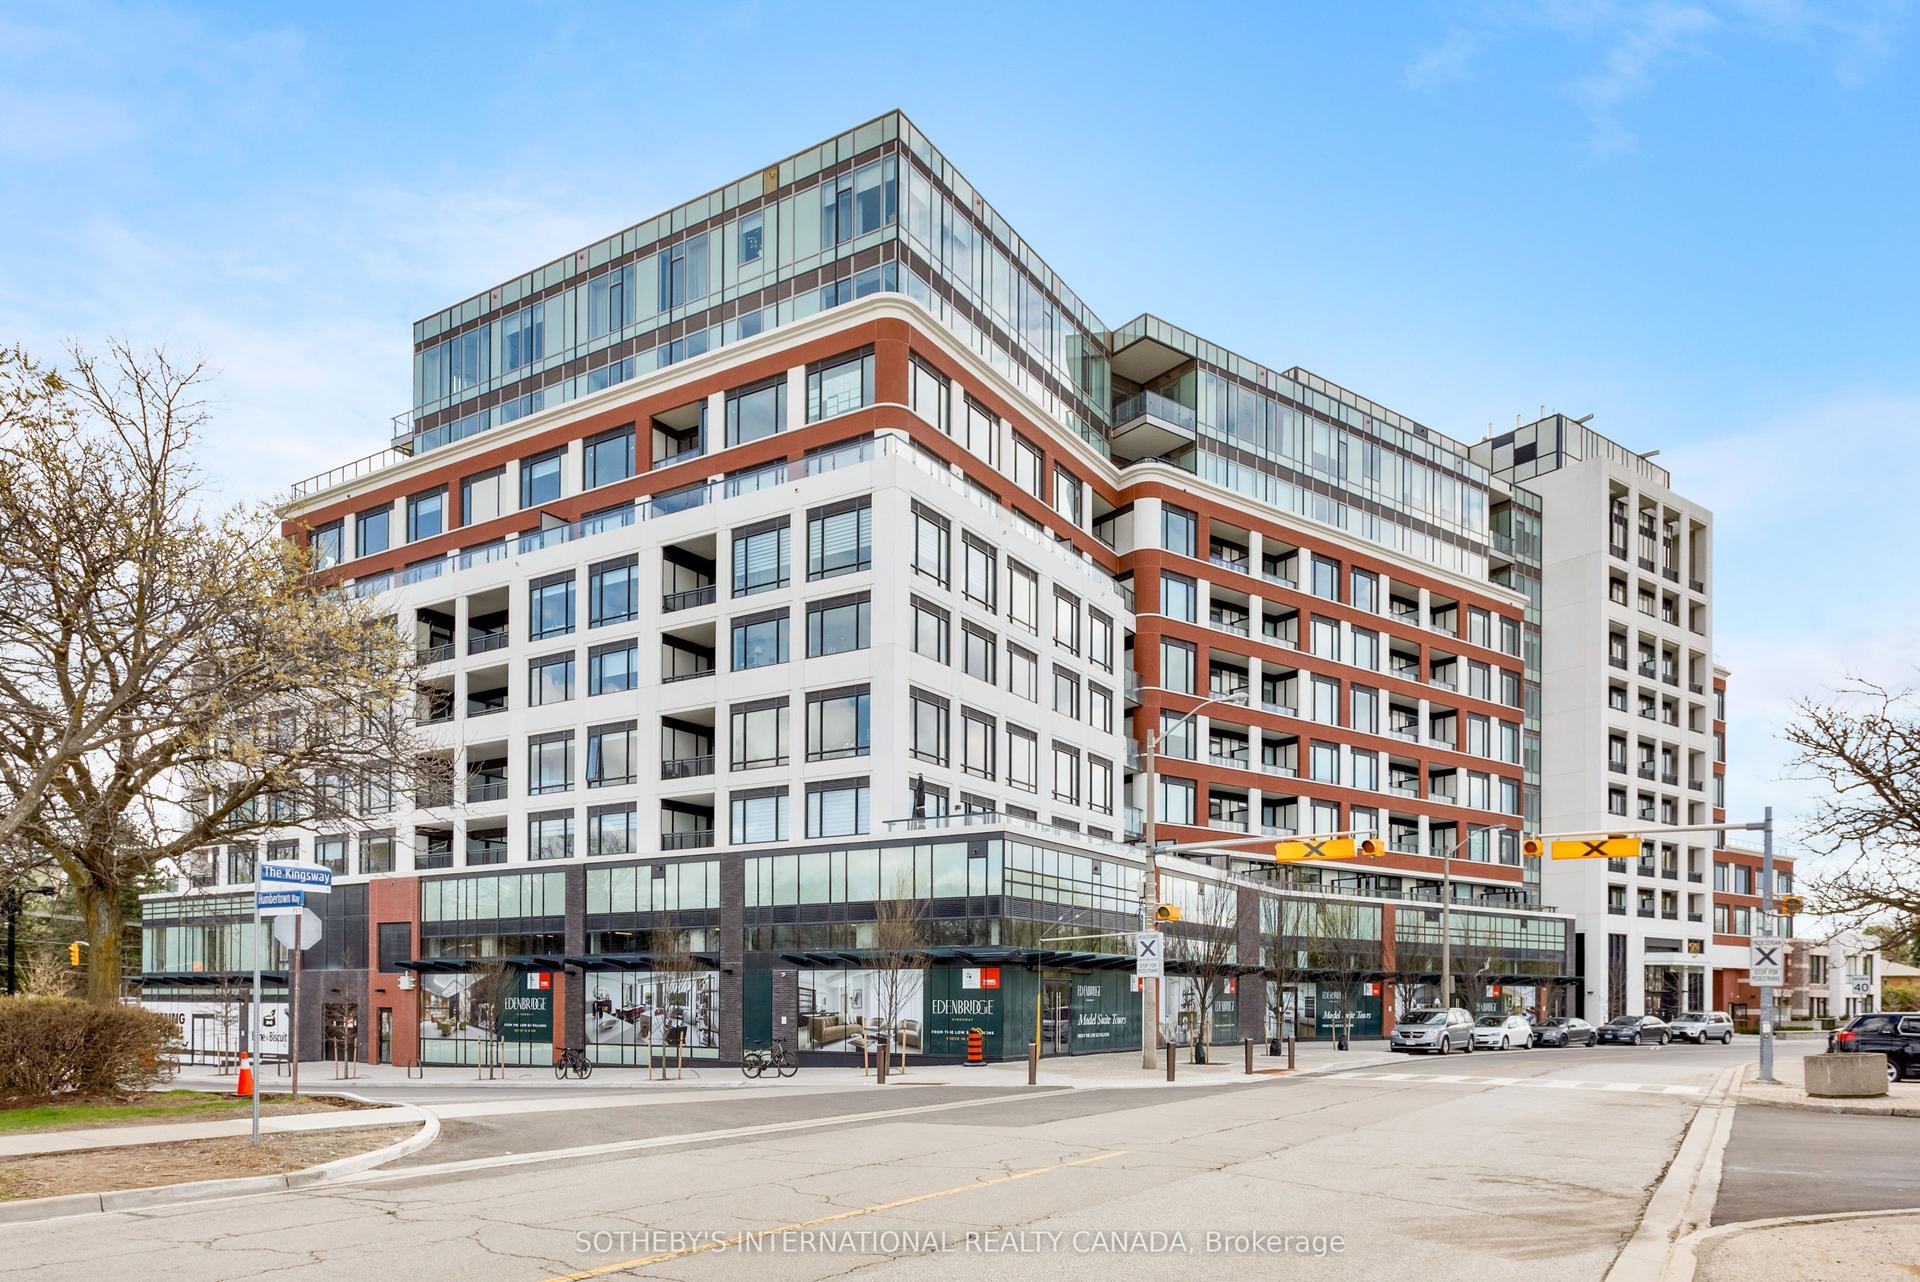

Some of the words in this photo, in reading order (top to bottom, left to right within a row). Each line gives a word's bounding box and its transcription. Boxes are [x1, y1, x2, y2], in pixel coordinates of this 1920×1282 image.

[264, 865, 282, 879] The
[285, 867, 330, 884] Kingsway
[258, 893, 291, 904] Humbertown
[291, 893, 301, 905] Way
[1854, 983, 1869, 992] 40
[504, 998, 547, 1010] EDENBRIDGE
[932, 1000, 994, 1015] EDENBRIDGE
[1078, 1013, 1097, 1025] Model
[1097, 1013, 1111, 1025] Suite
[1112, 1013, 1127, 1024] Tours
[269, 1031, 287, 1042] Biscuit
